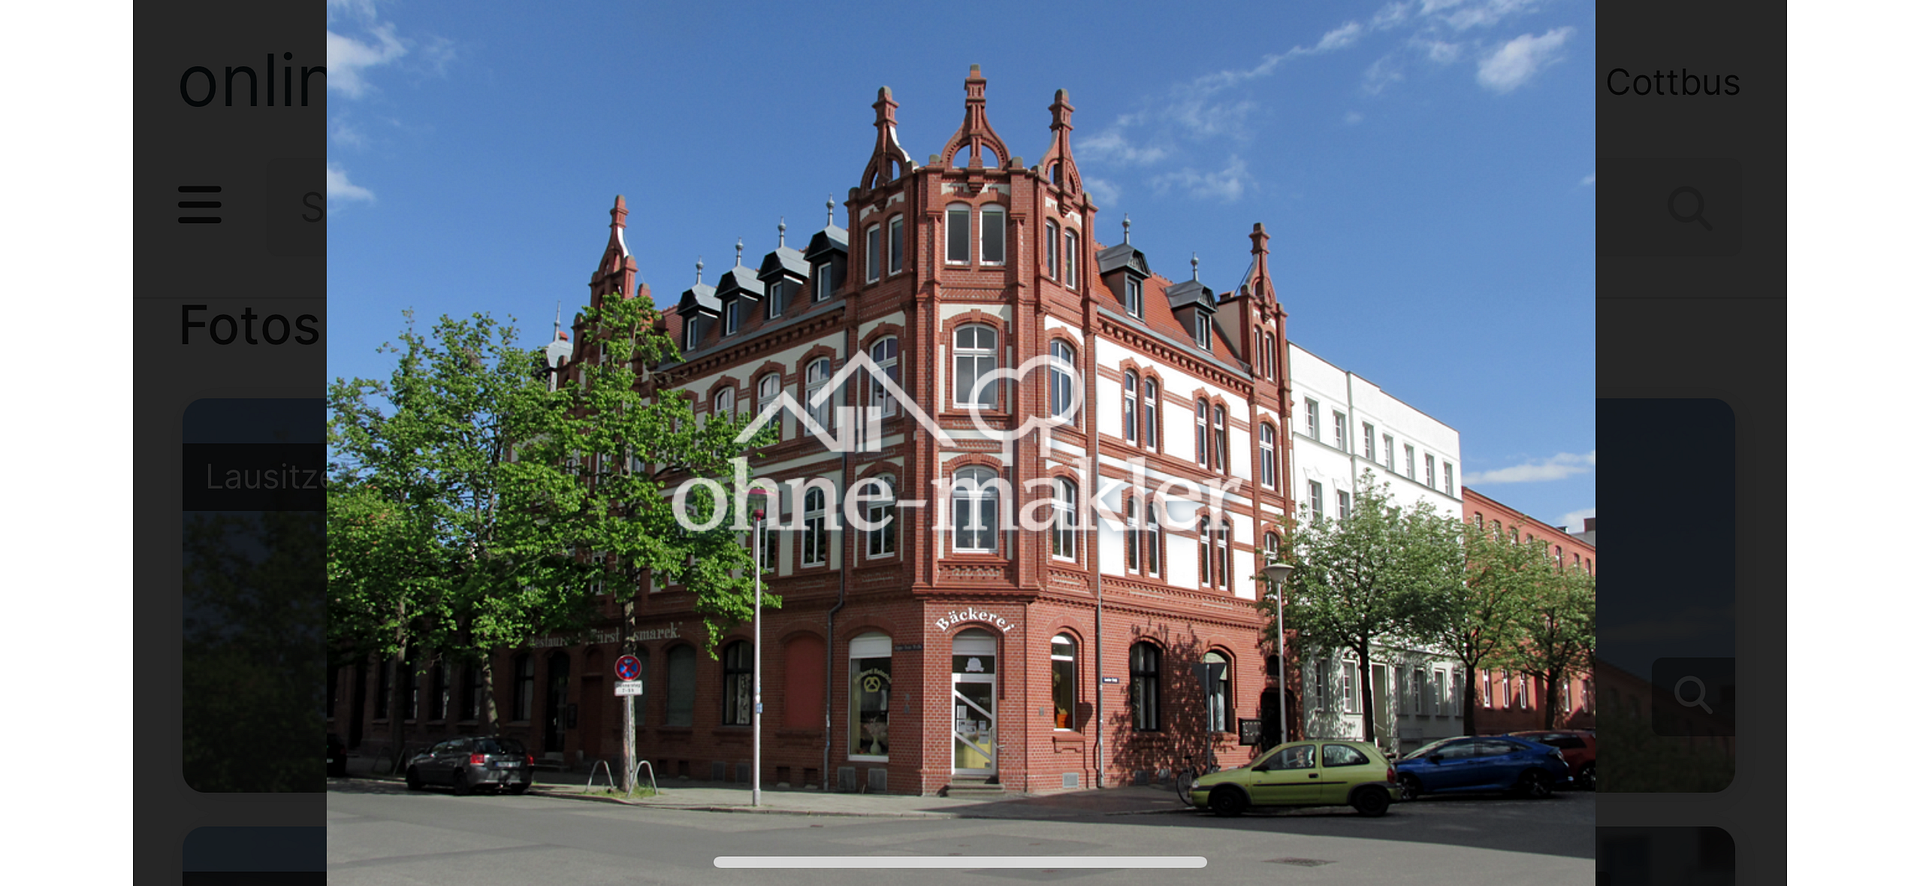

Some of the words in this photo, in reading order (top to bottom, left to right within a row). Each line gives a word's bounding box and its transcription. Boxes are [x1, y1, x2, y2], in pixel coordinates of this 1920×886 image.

[1606, 67, 1741, 96] Cottbus
[181, 304, 320, 345] Fotos
[935, 607, 1015, 633] Bäckerei
